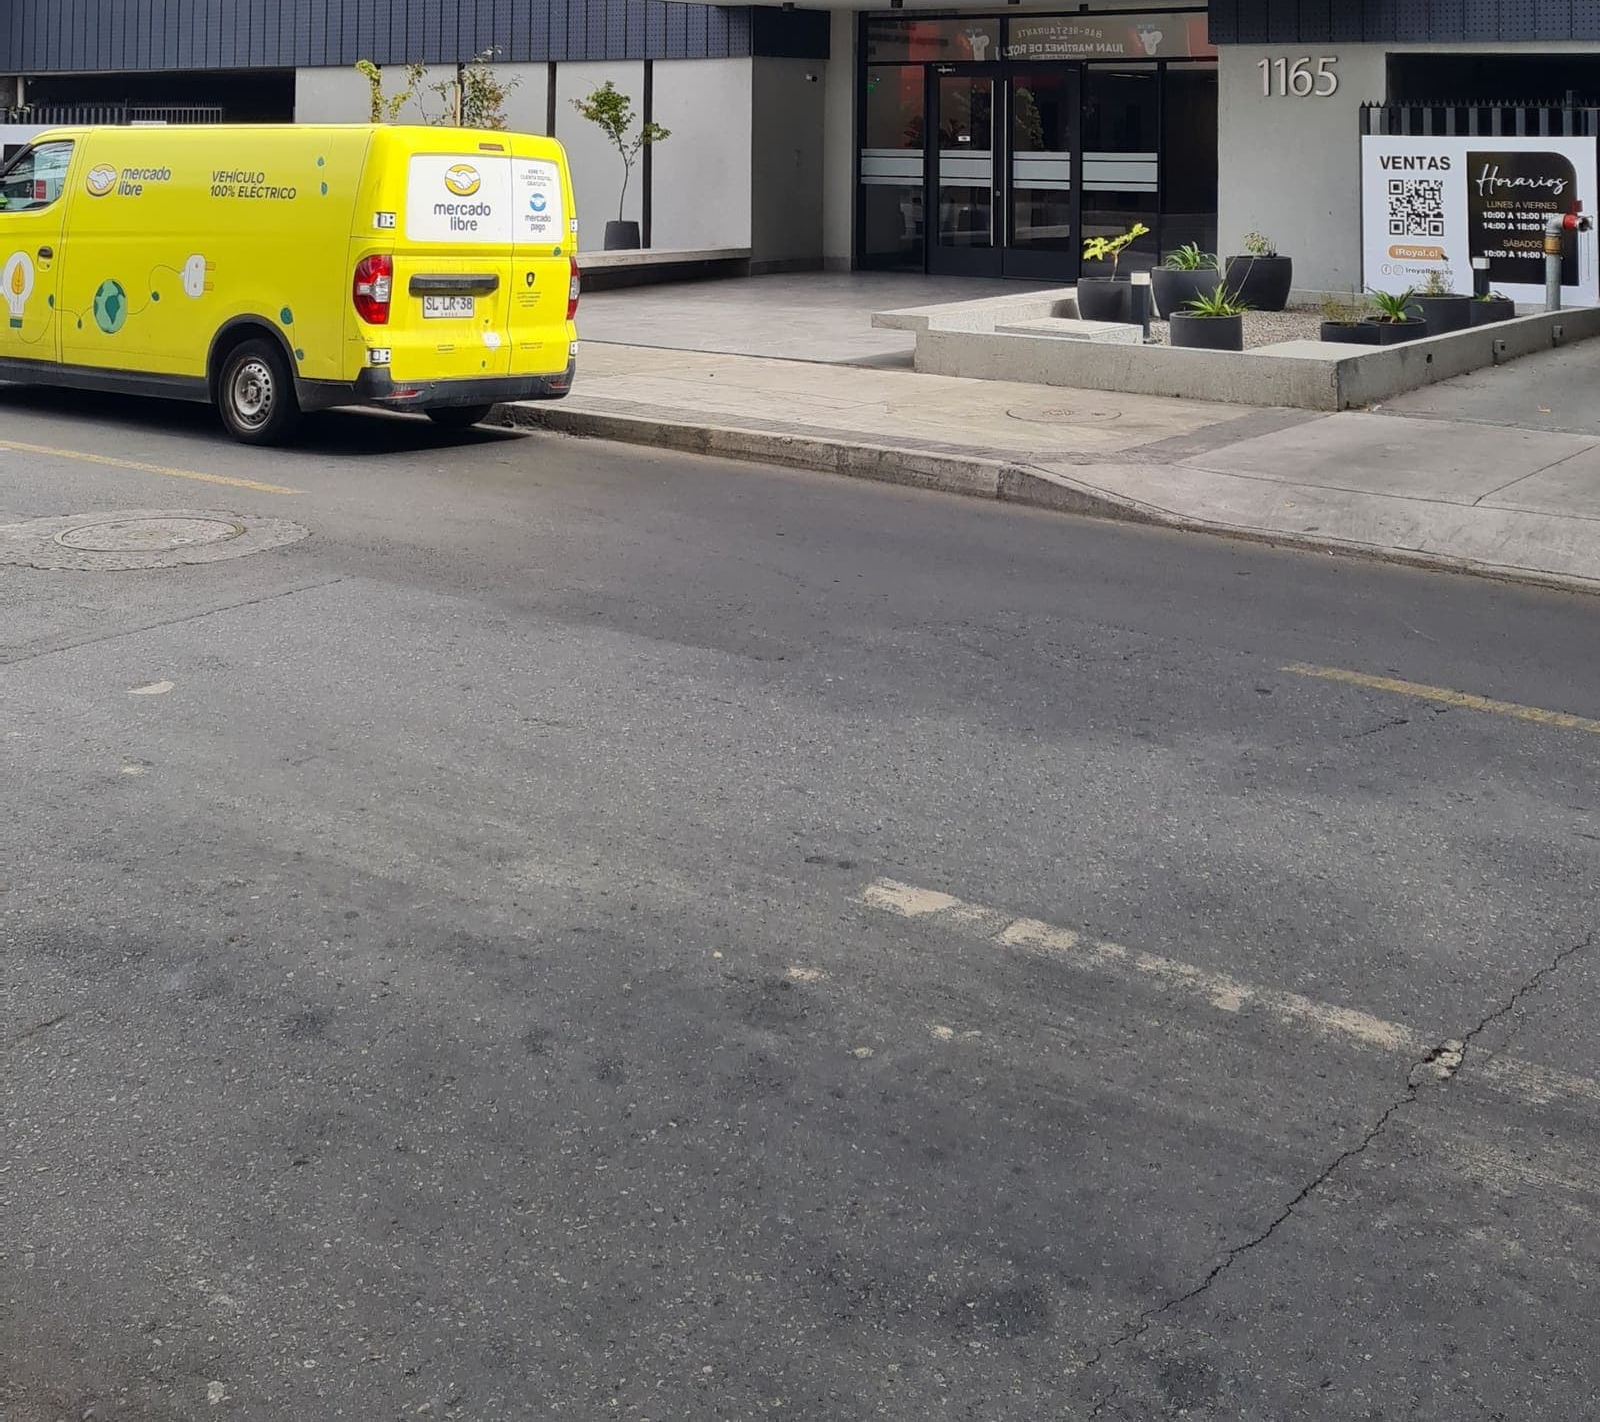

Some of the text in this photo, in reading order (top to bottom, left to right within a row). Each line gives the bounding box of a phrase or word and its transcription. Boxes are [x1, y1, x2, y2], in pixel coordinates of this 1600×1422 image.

[1257, 57, 1338, 97] 1165
[1380, 156, 1451, 170] VENTAS
[121, 165, 171, 181] mercado
[212, 168, 265, 184] VEHÍCULO
[1476, 164, 1568, 196] Horarios
[117, 181, 143, 196] libre
[209, 183, 297, 200] 100% ELÉCTRICO
[433, 202, 491, 216] mercado
[1516, 212, 1540, 220] 13:00
[450, 217, 478, 231] libre
[525, 214, 552, 222] mercado
[531, 224, 546, 233] pago
[1482, 222, 1506, 230] 14:00
[1503, 239, 1543, 248] SÁBADOS
[1483, 250, 1507, 258] 10:00
[1517, 251, 1540, 259] 14:00
